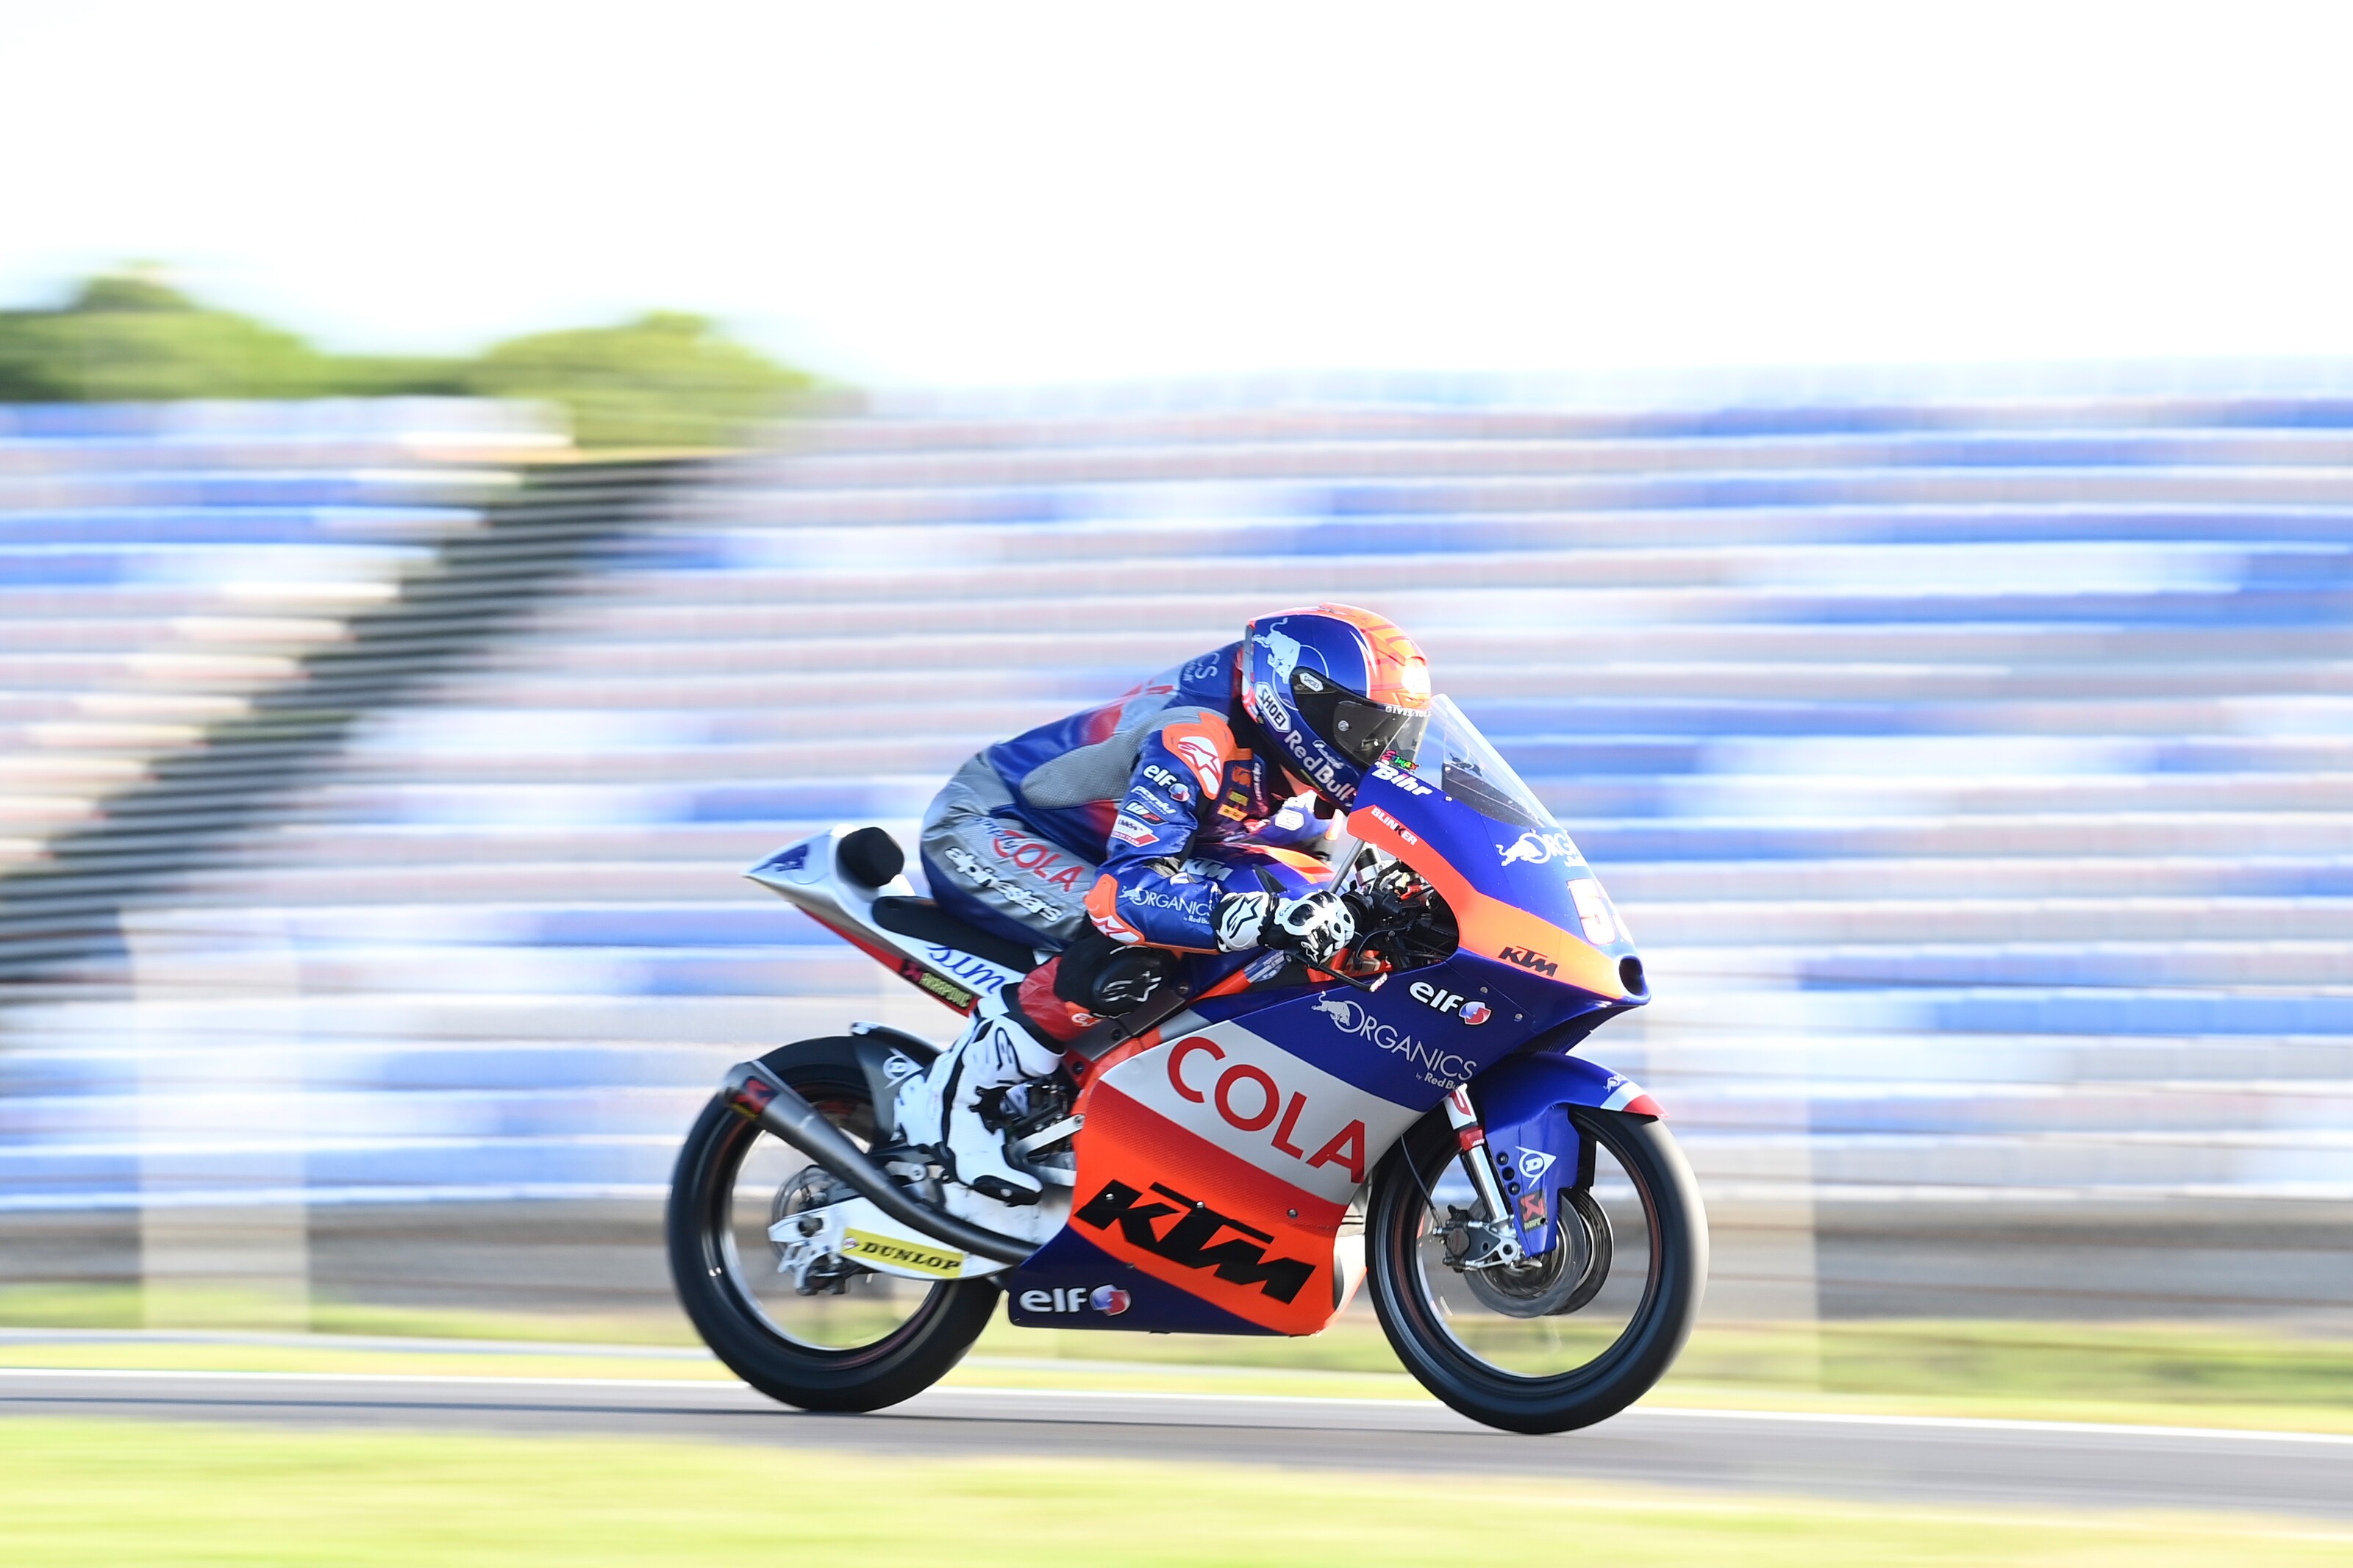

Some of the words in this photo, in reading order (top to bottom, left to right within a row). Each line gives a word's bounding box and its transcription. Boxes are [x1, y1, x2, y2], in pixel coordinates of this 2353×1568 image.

[1258, 689, 1286, 727] SHOEI
[1143, 765, 1176, 787] elf
[1284, 730, 1324, 771] Red
[1314, 765, 1356, 801] Bull
[1371, 766, 1433, 797] Bihr
[1126, 802, 1161, 821] WP
[1371, 807, 1418, 846] BLINKER
[994, 830, 1085, 892] COLA
[1518, 831, 1578, 864] ORG
[945, 846, 1063, 922] alpinestars
[1179, 857, 1234, 881] KTM
[1201, 917, 1210, 925] Bu
[1499, 946, 1559, 978] KTM
[1410, 981, 1464, 1013] elf
[1331, 1000, 1477, 1081] ORGANICS
[1424, 1073, 1446, 1088] Red
[1445, 1079, 1459, 1090] Bu
[1168, 1037, 1365, 1184] COLA
[859, 1242, 961, 1271] DUNLOP
[1075, 1179, 1315, 1304] KTM
[1020, 1288, 1089, 1312] elf
